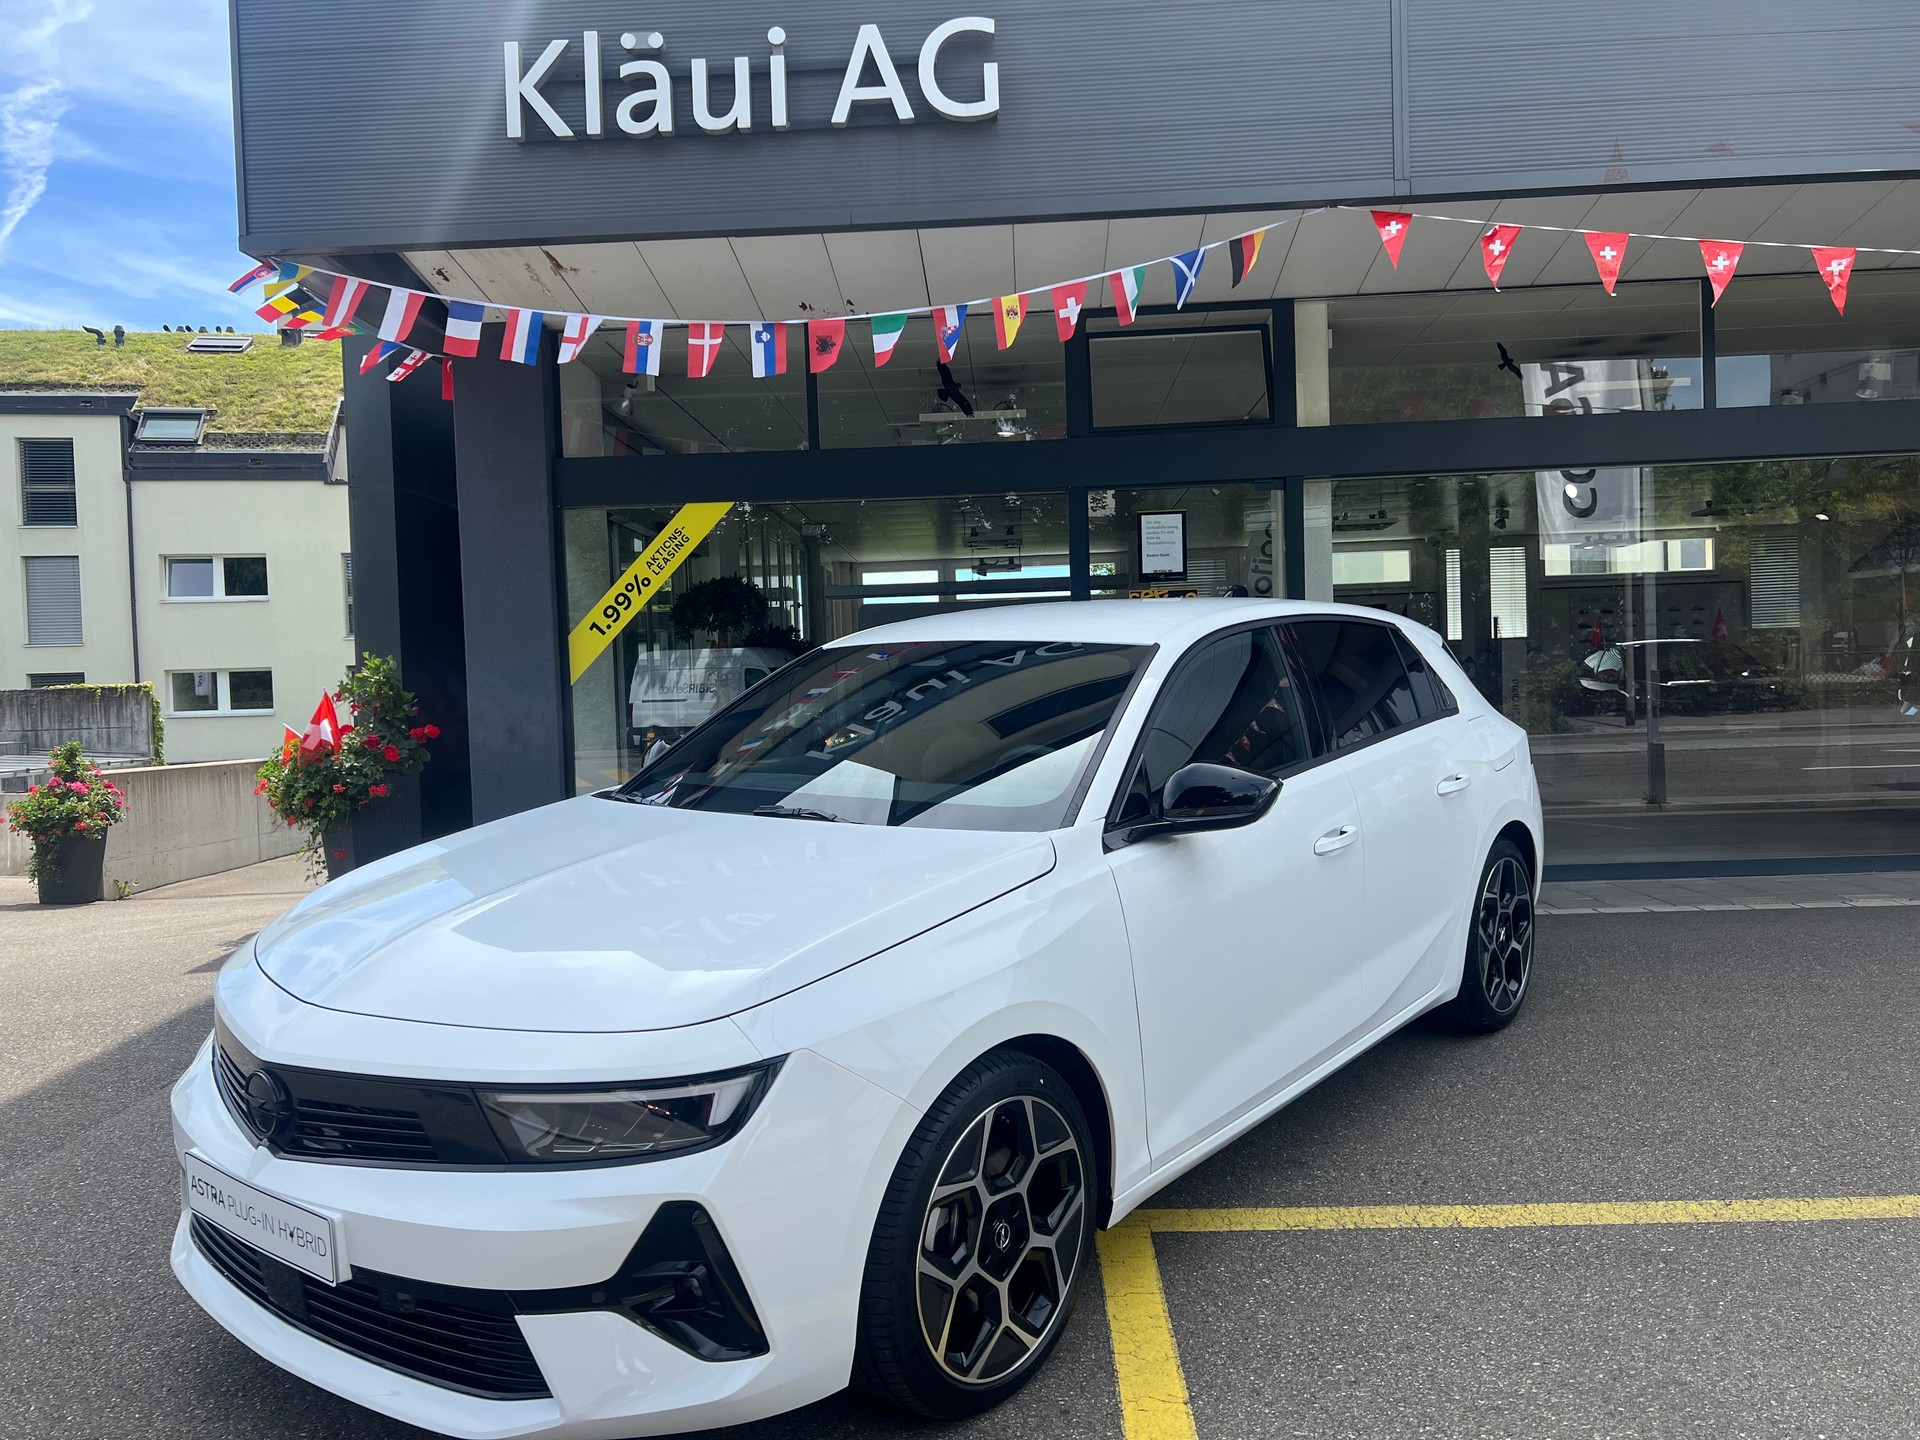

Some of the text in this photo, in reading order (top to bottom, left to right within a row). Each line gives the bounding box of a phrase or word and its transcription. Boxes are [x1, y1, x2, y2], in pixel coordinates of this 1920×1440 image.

[503, 17, 999, 142] Kläui AG
[645, 525, 686, 570] AKTIONS-
[651, 534, 691, 576] LEASING
[588, 573, 652, 637] 1.99%
[190, 1174, 328, 1258] ASTRA PLUG-IN HYBRID
